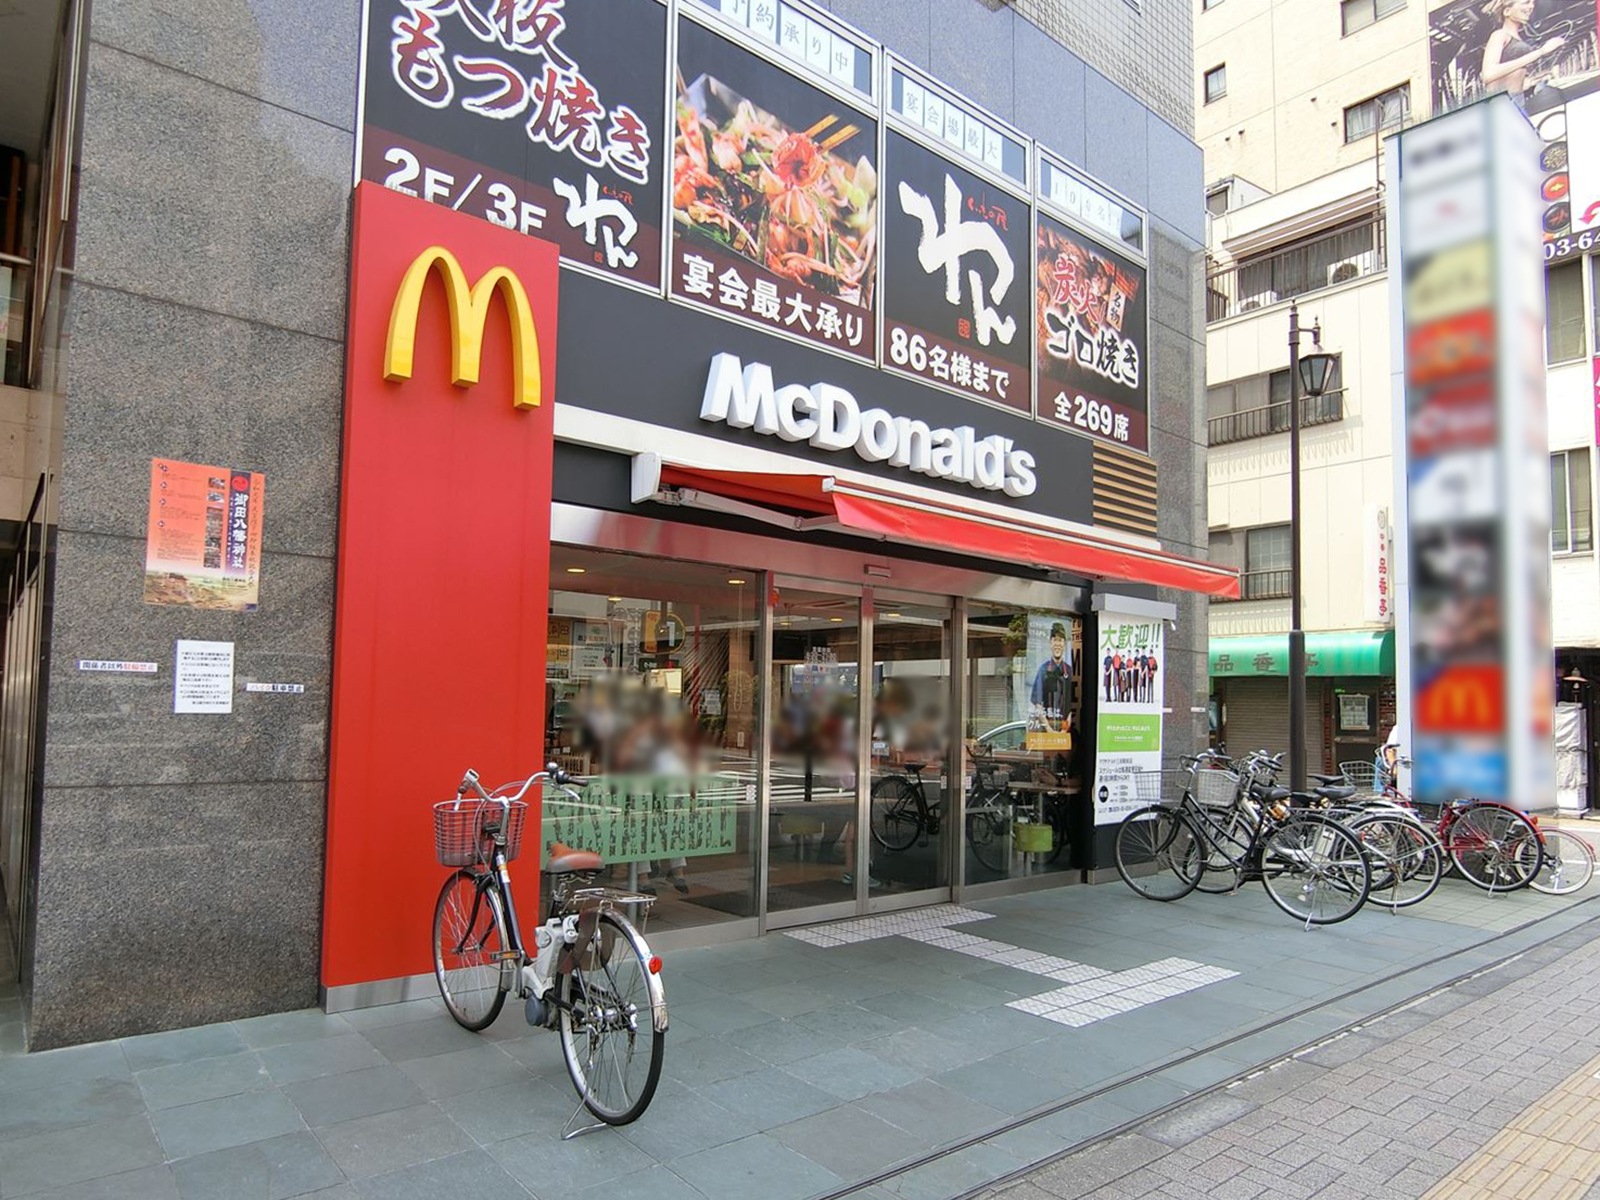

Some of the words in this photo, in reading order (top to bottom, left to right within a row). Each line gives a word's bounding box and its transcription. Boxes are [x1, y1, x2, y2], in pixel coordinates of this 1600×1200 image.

[391, 8, 651, 185] もつ焼き
[683, 254, 864, 347] 宴会最大承り
[890, 327, 1010, 399] 86名様まで
[1046, 311, 1139, 389] ゴロ焼き
[700, 352, 1038, 498] McDonald's
[1053, 391, 1130, 442] 全269席
